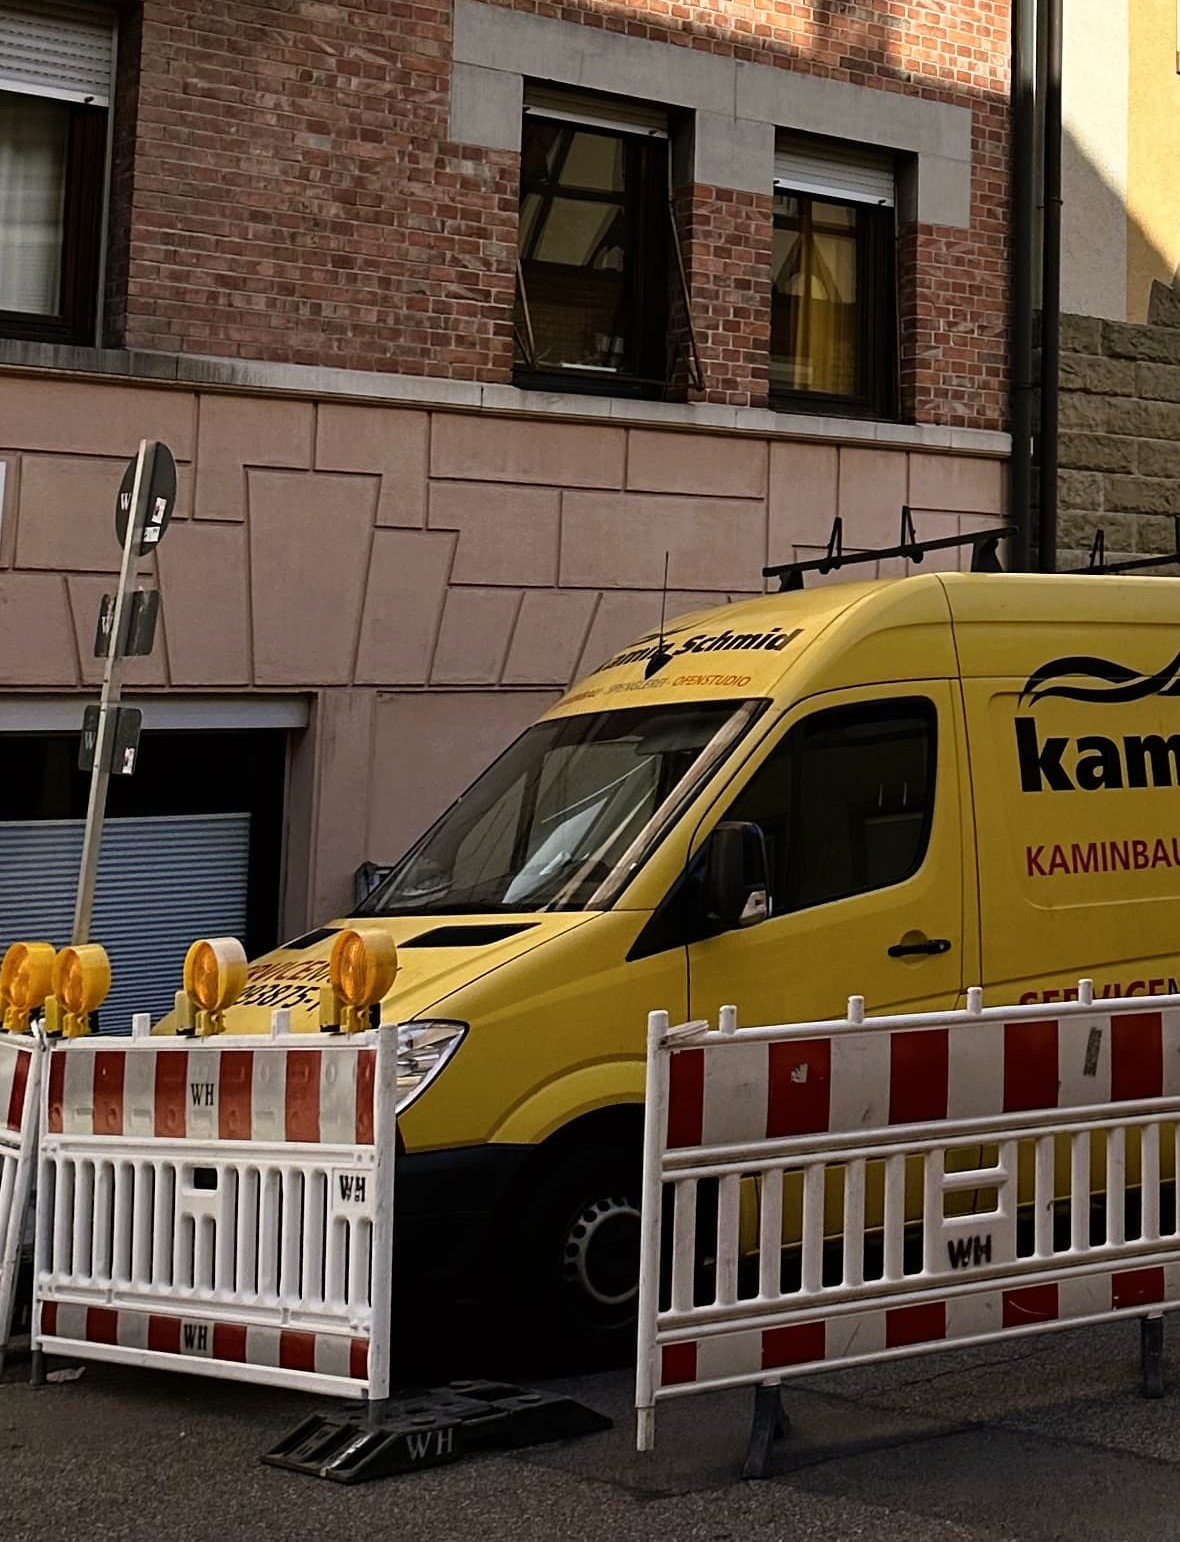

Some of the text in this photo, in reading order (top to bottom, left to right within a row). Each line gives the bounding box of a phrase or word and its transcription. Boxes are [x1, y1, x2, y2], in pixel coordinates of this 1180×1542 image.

[672, 627, 805, 656] Schmid
[672, 674, 752, 688] OFENSTUDIO
[190, 1083, 215, 1107] WH
[340, 1174, 367, 1203] WH
[947, 1233, 992, 1270] WH
[183, 1324, 209, 1352] WH
[406, 1428, 454, 1461] WH
